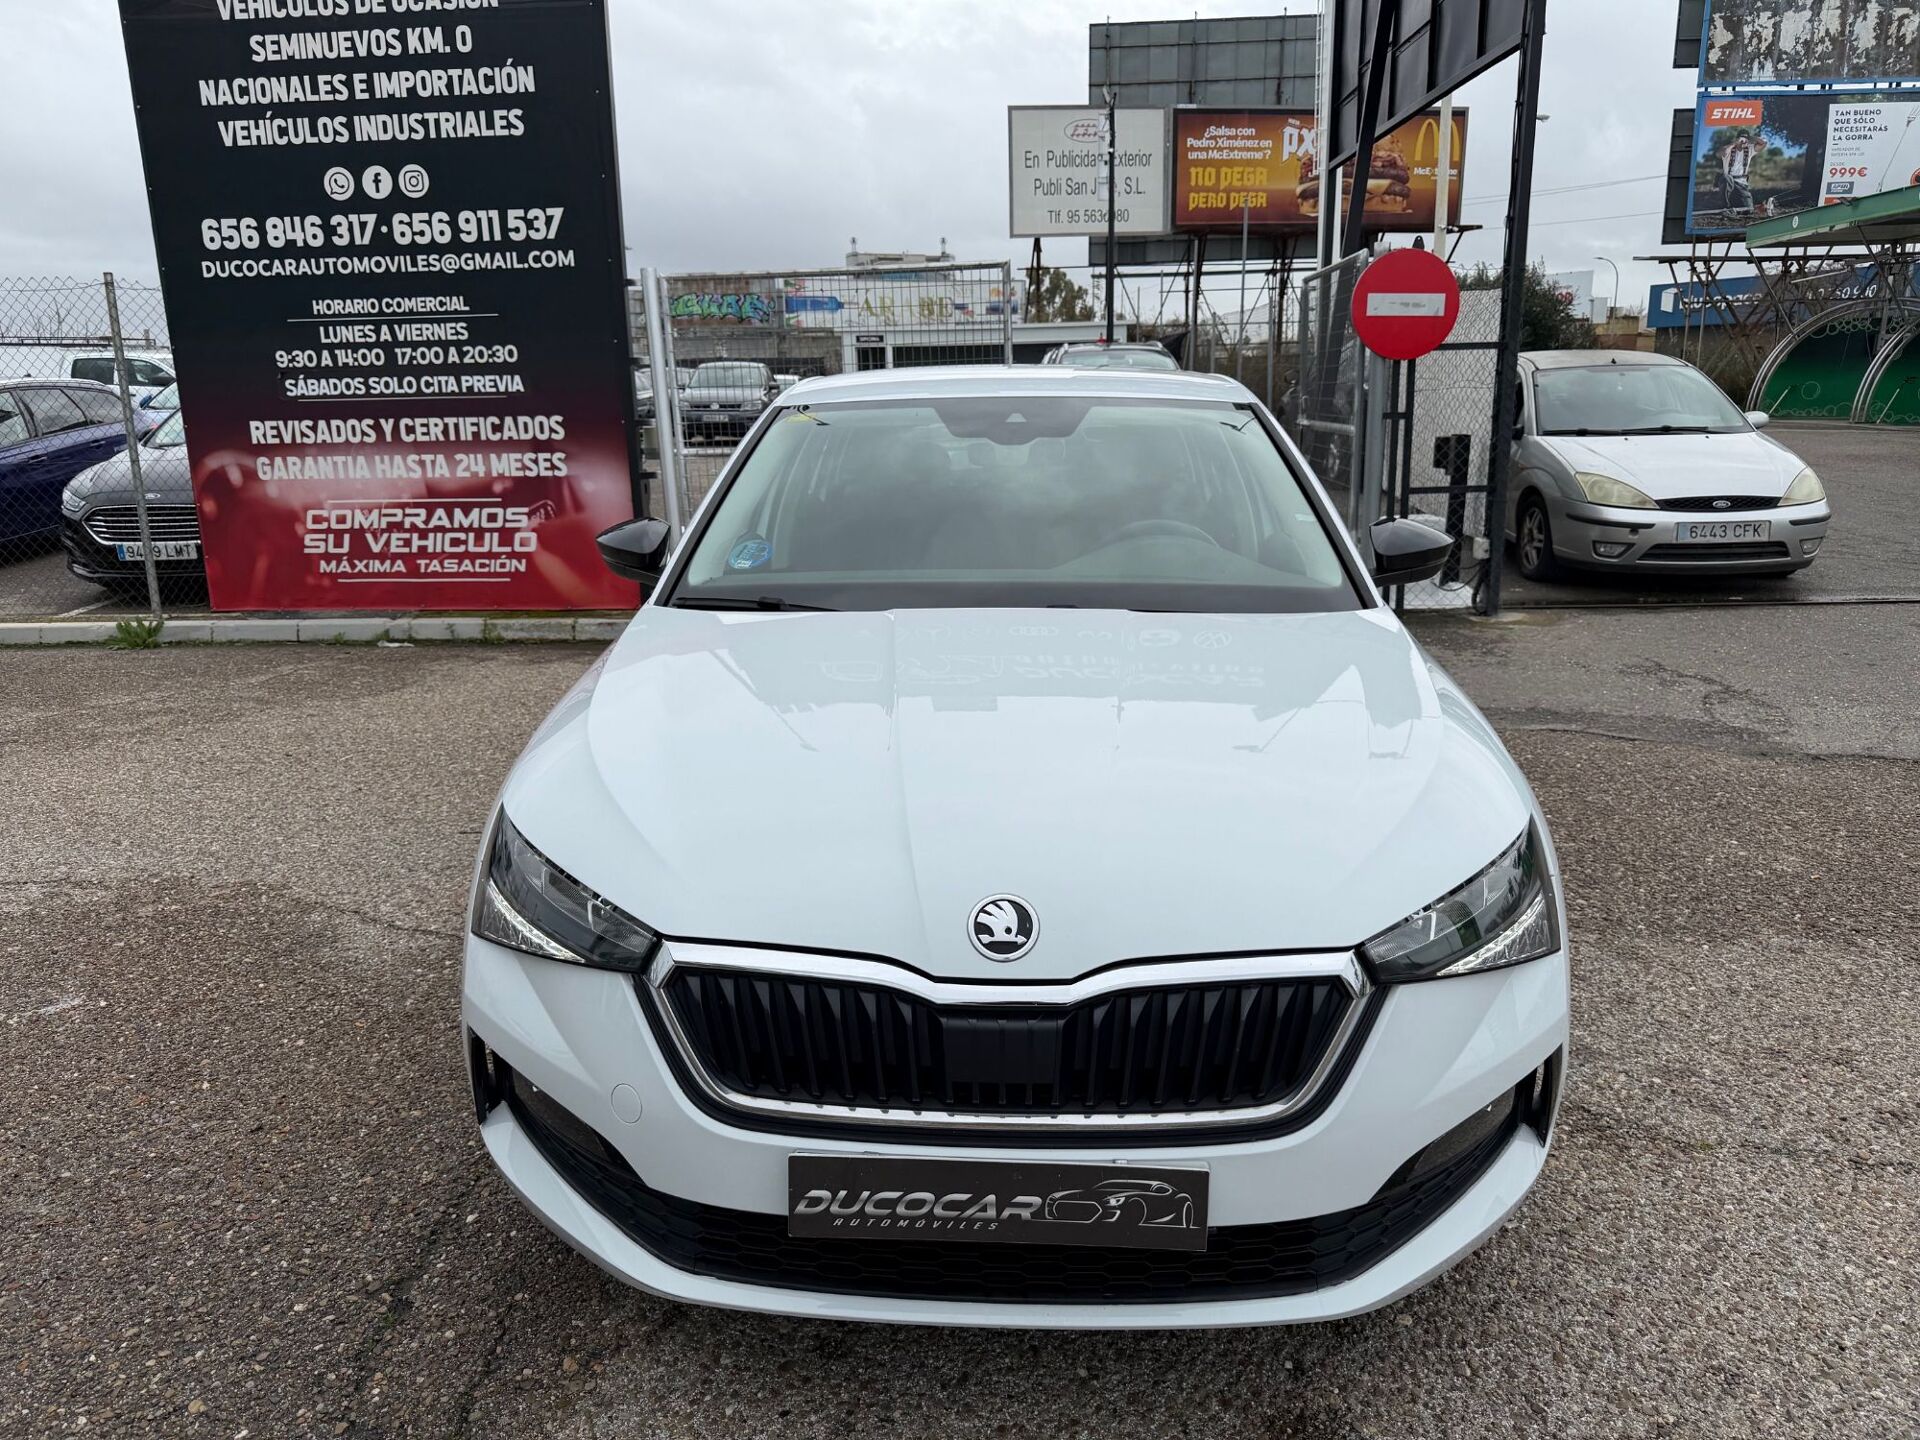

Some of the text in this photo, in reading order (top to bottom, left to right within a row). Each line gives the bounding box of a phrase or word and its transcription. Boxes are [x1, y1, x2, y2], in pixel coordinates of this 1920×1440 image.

[250, 25, 472, 62] SEMINUEVOS KM. 0
[199, 58, 535, 105] NACIONALES E IMPORTACIÓN
[1711, 108, 1755, 119] STIHL
[218, 109, 524, 146] VEHÍCULOS INDUSTRIALES
[1204, 126, 1256, 138] ¿Salsa con
[1833, 124, 1888, 133] NECESITARÁS
[1187, 138, 1215, 148] Pedro
[1216, 137, 1259, 148] Ximénez
[1025, 151, 1040, 168] En
[1047, 150, 1104, 168] Publicida
[1188, 151, 1207, 159] una
[1829, 167, 1867, 178] 999€
[1034, 178, 1062, 196] Publi
[1066, 177, 1087, 195] San
[1124, 176, 1145, 195] S.L.
[1048, 209, 1129, 223] Tlf. 95 563680
[202, 208, 564, 250] 656 846 317 656 911 537
[202, 250, 574, 277] DUCOCARAUTOMOVILES@GMAIL.COM
[313, 296, 469, 314] HORARIO COMERCIAL
[320, 322, 468, 343] LUNES A VIERNES
[276, 345, 517, 367] 9:30 A 14:00 17:00 A 20:30
[285, 375, 524, 396] SÁBADOS SOLO CITA PREVIA
[250, 415, 565, 444] REVISADOS Y CERTIFICADOS
[256, 452, 568, 480] GARANTIA HASTA 24 MESES
[305, 507, 529, 529] COMPRAMOS
[1690, 523, 1762, 539] 6443 CFK
[127, 544, 191, 558] 949 LMT
[304, 532, 538, 553] SU VEHICULO
[320, 555, 526, 573] MÁXIMA TASACIÓN
[794, 1190, 1043, 1220] DUCOCAR
[833, 1217, 999, 1231] AUTOMÓVILES
